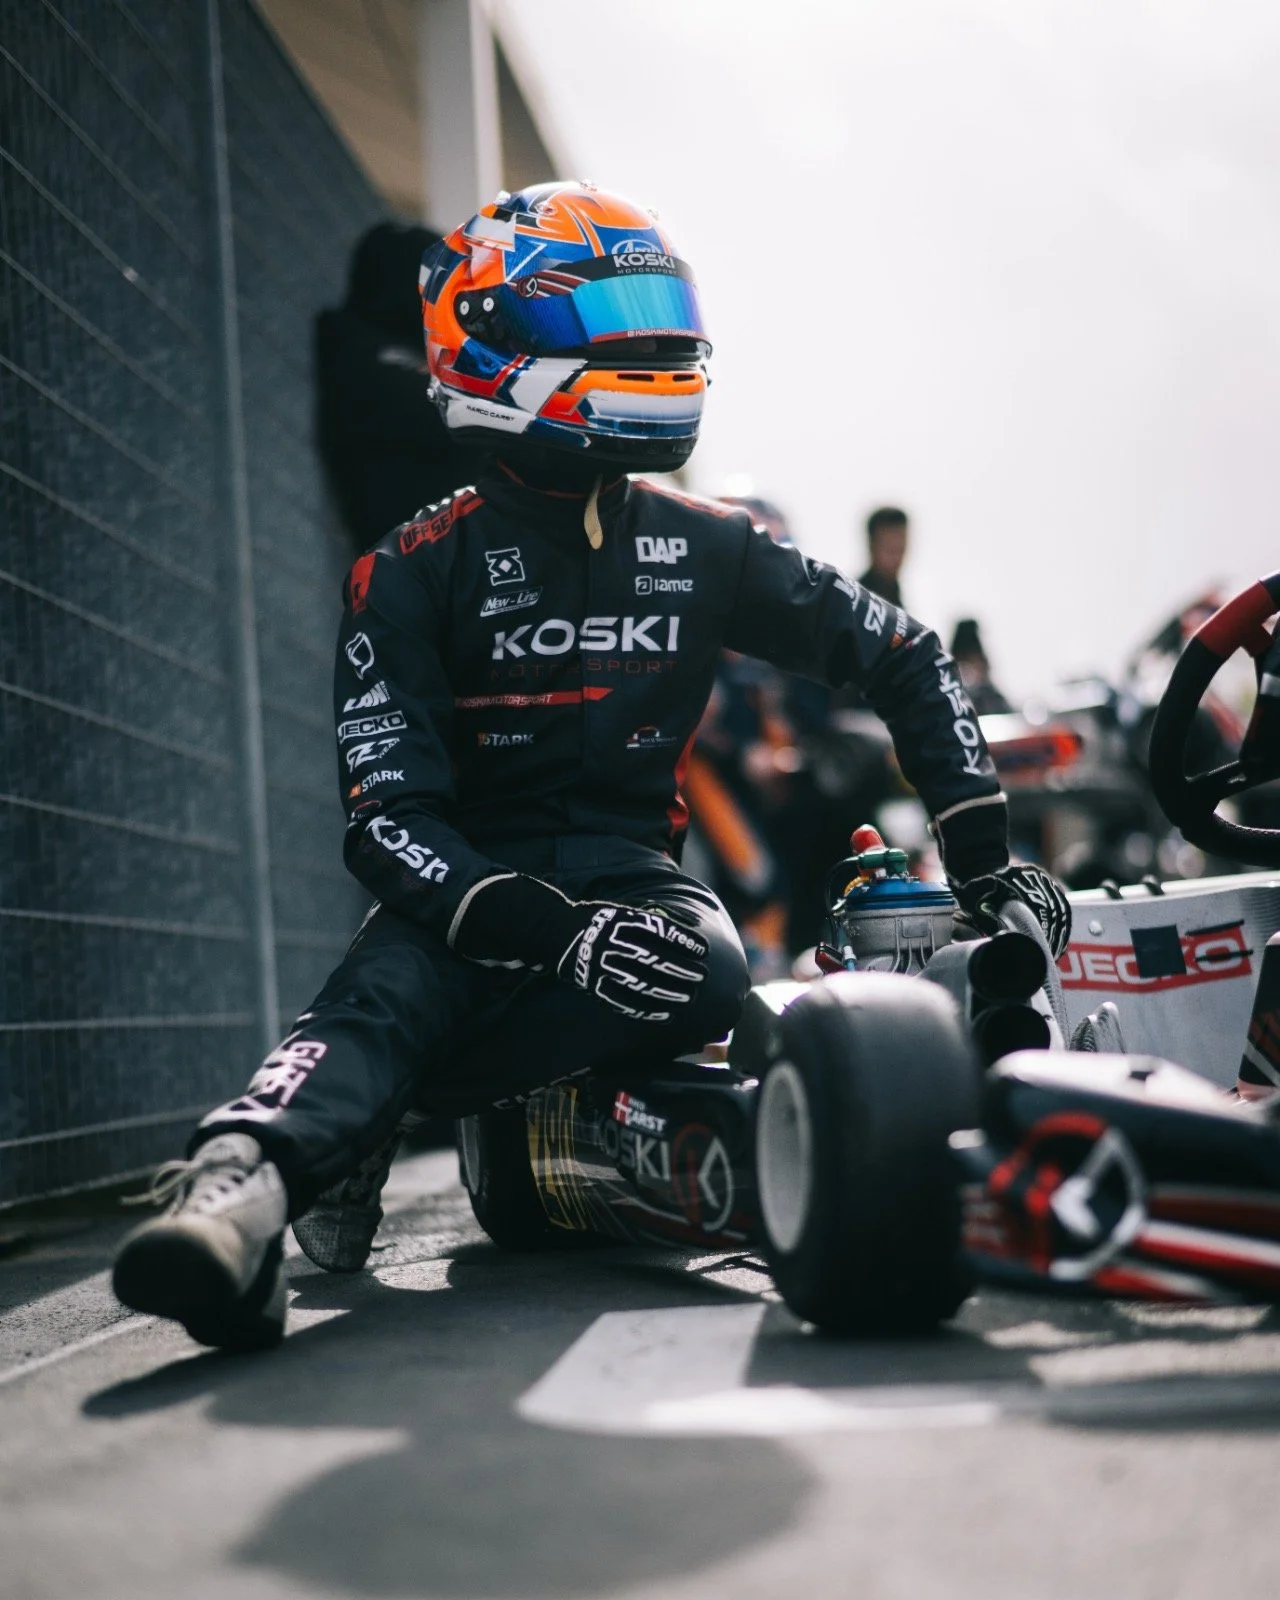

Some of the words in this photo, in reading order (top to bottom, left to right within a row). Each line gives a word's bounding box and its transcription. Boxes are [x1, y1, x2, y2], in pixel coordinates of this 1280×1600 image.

[613, 253, 676, 269] KOSKI
[635, 536, 688, 564] DAP
[492, 615, 680, 660] KOSKI
[361, 769, 405, 792] STARK
[667, 925, 706, 956] freem
[1057, 938, 1243, 985] JECO
